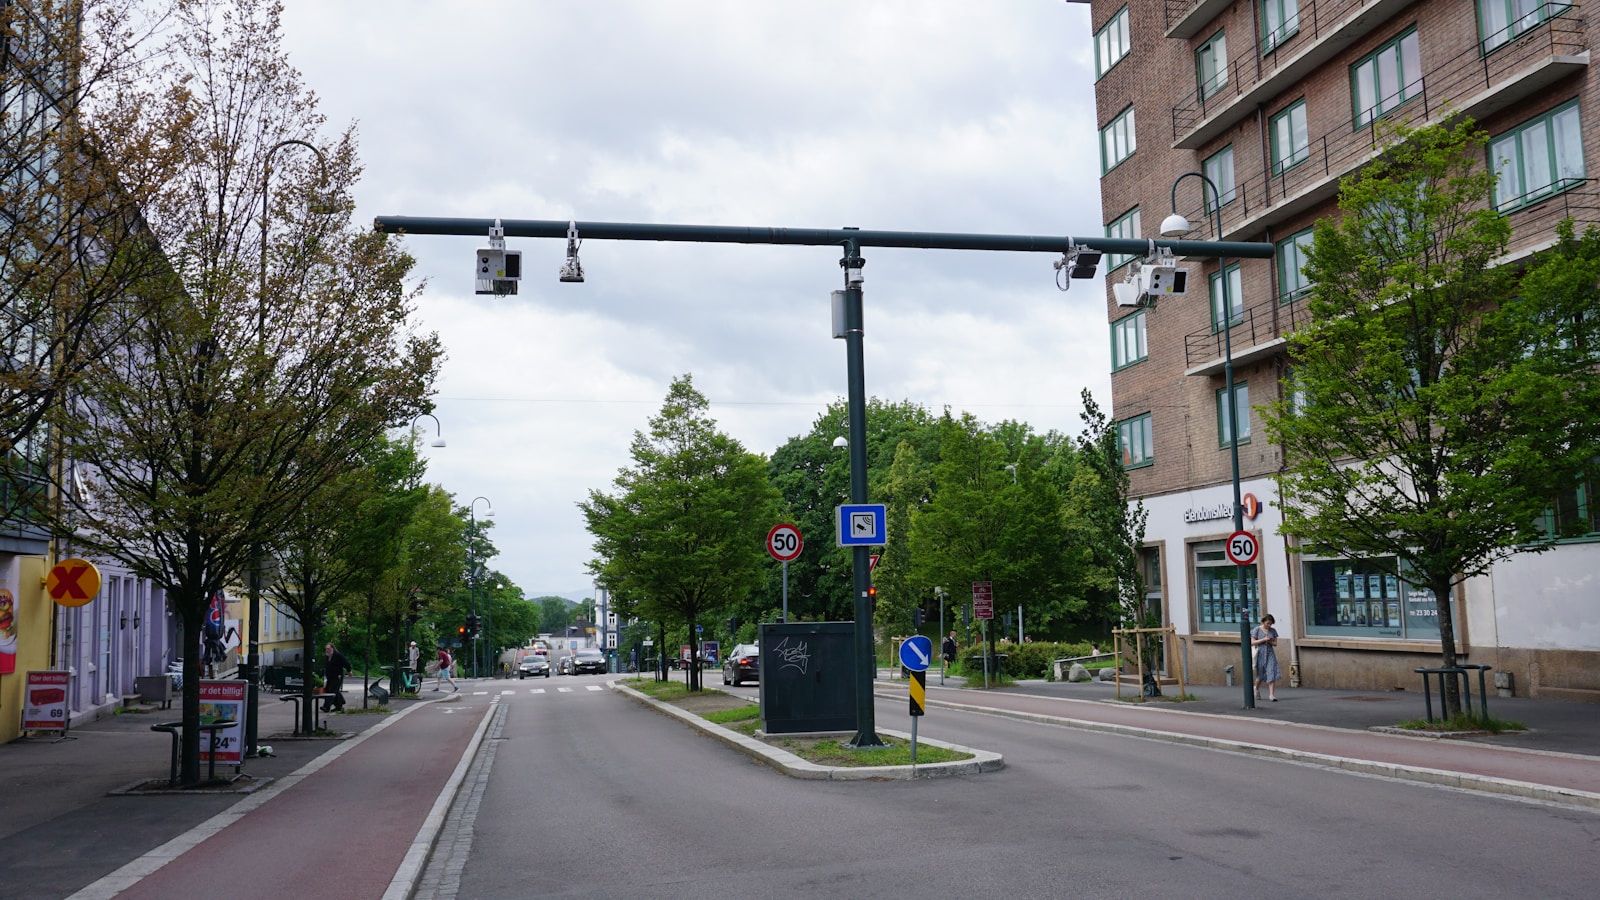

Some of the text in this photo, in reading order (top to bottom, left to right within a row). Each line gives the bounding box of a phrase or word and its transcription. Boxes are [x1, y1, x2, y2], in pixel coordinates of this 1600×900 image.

[774, 534, 797, 551] 50
[1232, 540, 1253, 557] 50
[50, 566, 89, 599] X
[208, 686, 220, 695] det
[222, 687, 243, 696] billig!
[50, 709, 63, 718] 69
